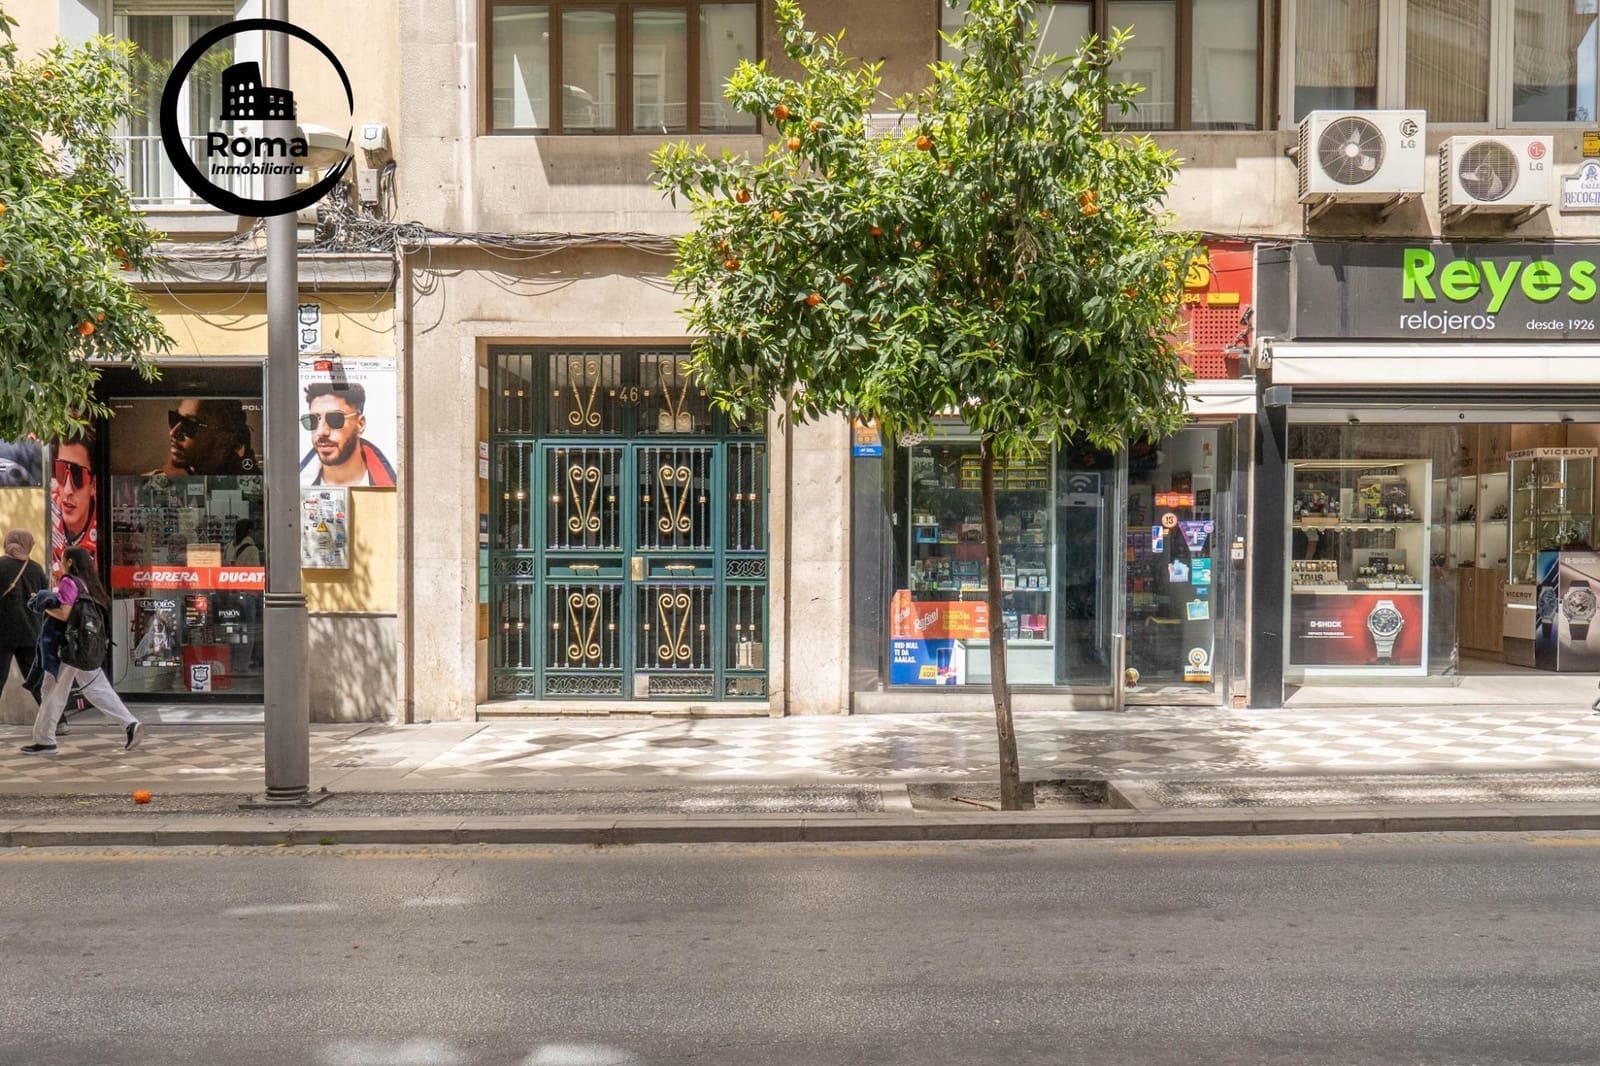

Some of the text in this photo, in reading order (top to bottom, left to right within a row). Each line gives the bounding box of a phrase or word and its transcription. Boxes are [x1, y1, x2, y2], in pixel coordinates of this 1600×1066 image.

[1400, 140, 1416, 149] LG
[1529, 163, 1544, 171] LG
[1565, 191, 1600, 204] RECOGI
[1403, 248, 1597, 313] Reyes
[1400, 310, 1496, 334] relojeros
[1526, 319, 1595, 330] desde 1926
[619, 386, 638, 402] 46
[1542, 448, 1593, 456] VICEROY
[132, 571, 266, 583] CARRERA DUCAT
